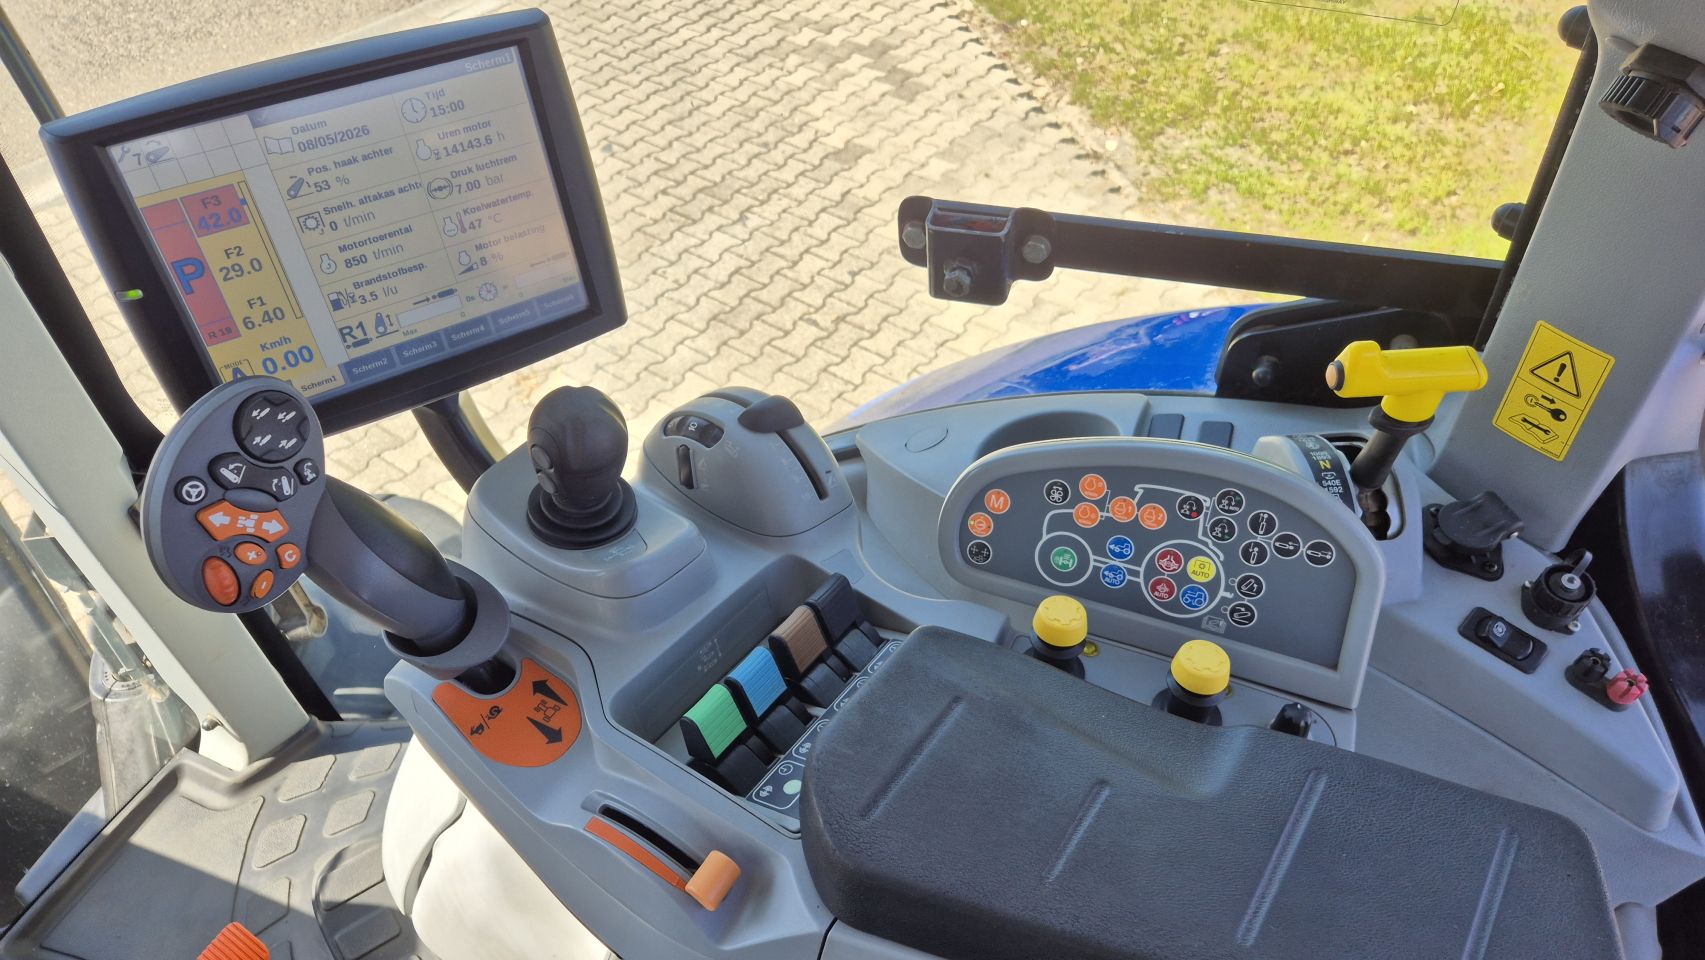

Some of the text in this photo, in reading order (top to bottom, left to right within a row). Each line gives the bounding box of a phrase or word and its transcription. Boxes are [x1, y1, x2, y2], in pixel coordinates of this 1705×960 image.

[465, 52, 511, 72] Scherm1
[425, 88, 446, 101] Tijd
[430, 99, 465, 118] 15:00
[291, 119, 327, 136] Datum
[437, 119, 492, 141] Uren motor
[297, 124, 370, 153] 08/05/2026
[443, 131, 505, 157] 14143.6 h
[132, 153, 142, 166] 7
[306, 146, 394, 177] Pos. haak achter
[450, 154, 518, 179] Druk luchtrem
[313, 175, 350, 194] 53 %
[455, 173, 504, 195] 7.00 bar
[202, 195, 222, 209] F3
[323, 200, 356, 216] Snelh.
[358, 189, 396, 206] aftakas
[463, 190, 535, 216] Koelwatertemp.
[197, 207, 242, 231] 42.0
[329, 210, 376, 231] 0 t/min
[468, 218, 482, 231] 47
[338, 224, 413, 254] Motortoerental
[474, 225, 545, 252] Motor belasting
[224, 245, 245, 260] F2
[344, 244, 404, 269] 850 t/min
[479, 256, 488, 266] 8
[171, 257, 205, 295] P
[219, 257, 263, 282] 29.0
[352, 262, 428, 290] Brandstofbesp.
[247, 296, 267, 310] F1
[358, 285, 399, 305] 3.5 l/u
[242, 306, 286, 331] 6.40
[208, 331, 218, 340] R
[338, 320, 368, 343] R1
[402, 328, 418, 337] Max
[450, 324, 486, 341] Scherm4
[260, 335, 292, 352] Km/h
[402, 341, 438, 357] Scherm3
[262, 344, 315, 375] 0.00
[352, 357, 388, 375] Scherm2
[301, 375, 337, 392] Scherm1
[688, 421, 698, 432] 10
[1319, 460, 1332, 470] N
[990, 494, 1005, 510] M
[1104, 577, 1120, 586] AUTO
[1191, 569, 1210, 579] AUTO
[1153, 591, 1169, 599] AUTO
